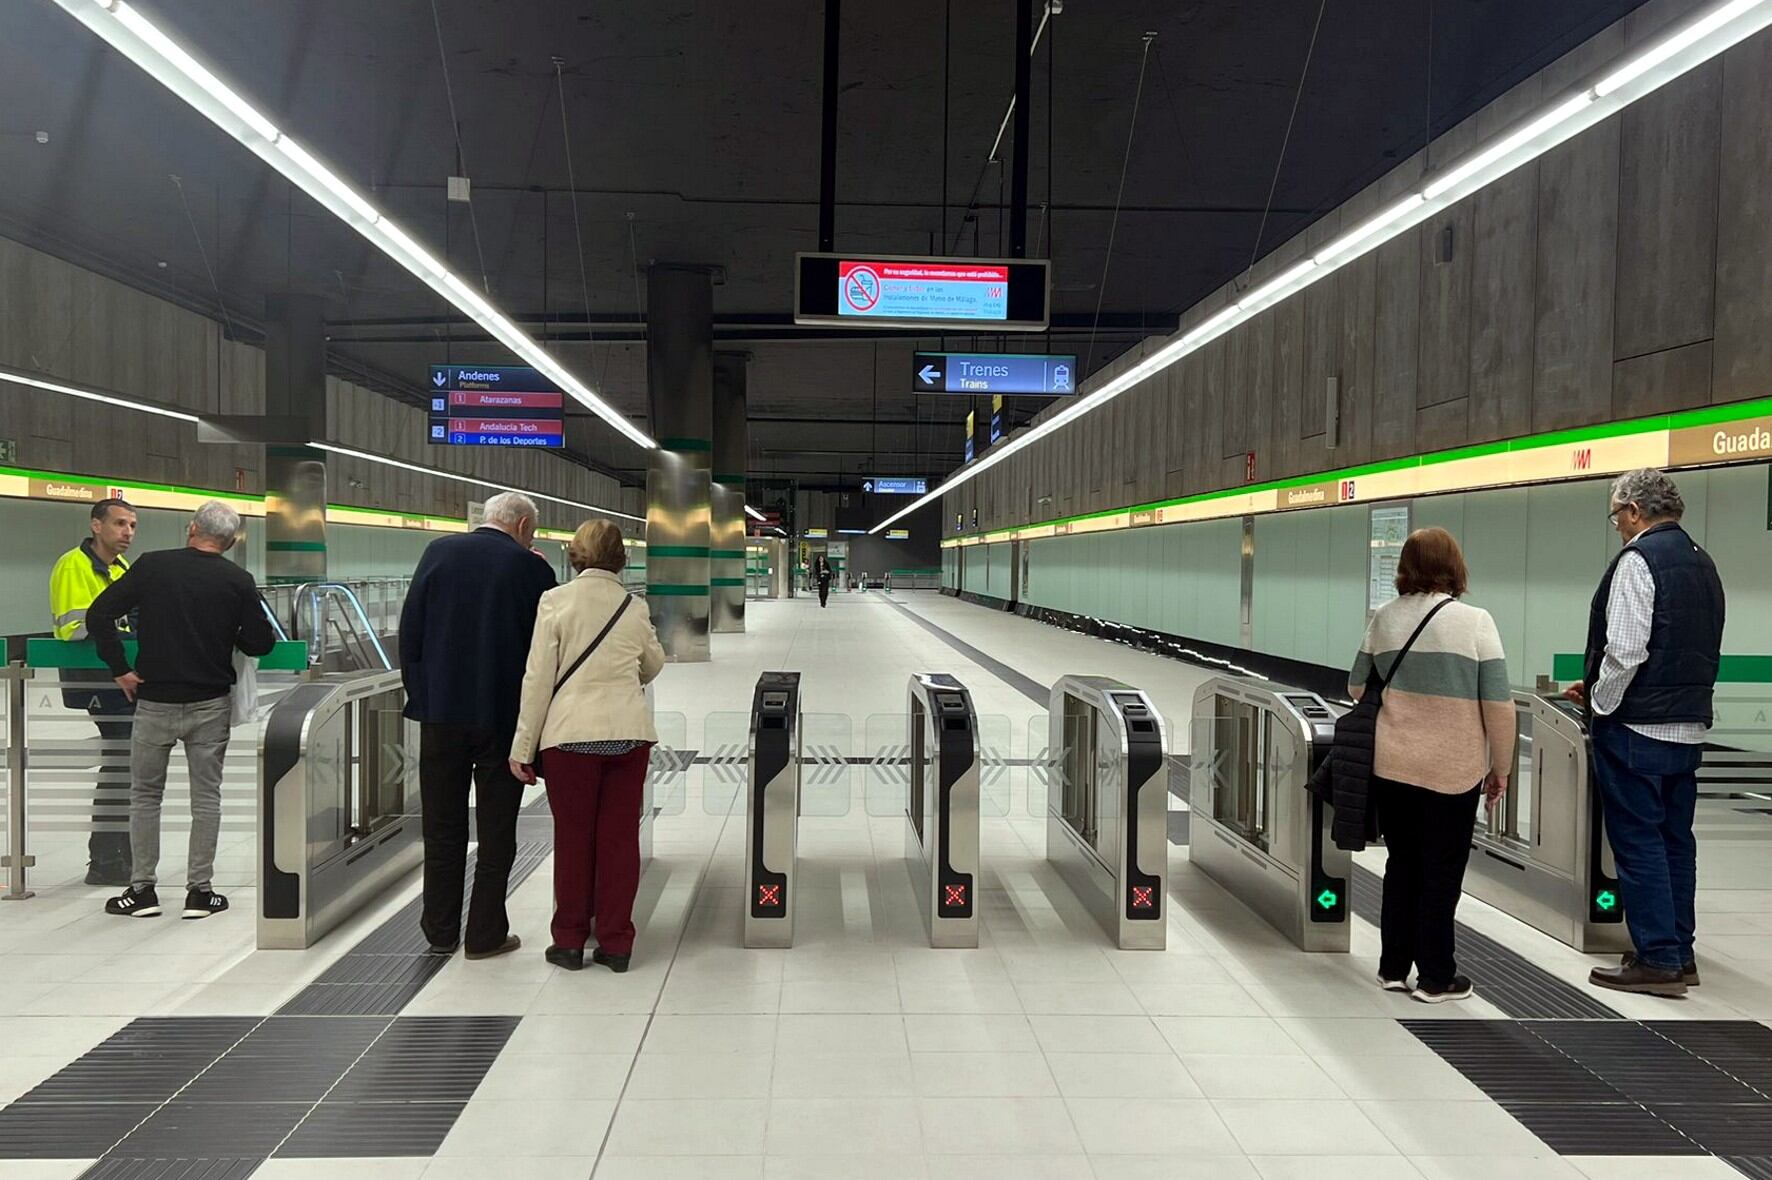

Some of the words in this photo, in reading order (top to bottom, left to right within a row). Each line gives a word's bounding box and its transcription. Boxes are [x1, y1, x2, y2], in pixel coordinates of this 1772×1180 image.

[960, 361, 1009, 377] Trenes
[458, 370, 500, 381] Andenes
[960, 378, 988, 390] Trains
[480, 395, 522, 404] Atarazanas
[519, 423, 538, 432] Tech
[487, 436, 499, 444] de
[499, 436, 511, 445] los
[512, 436, 548, 446] Deportes
[1713, 426, 1772, 455] Guada
[878, 480, 907, 488] Ascensor
[46, 484, 93, 499] Guadalmedina
